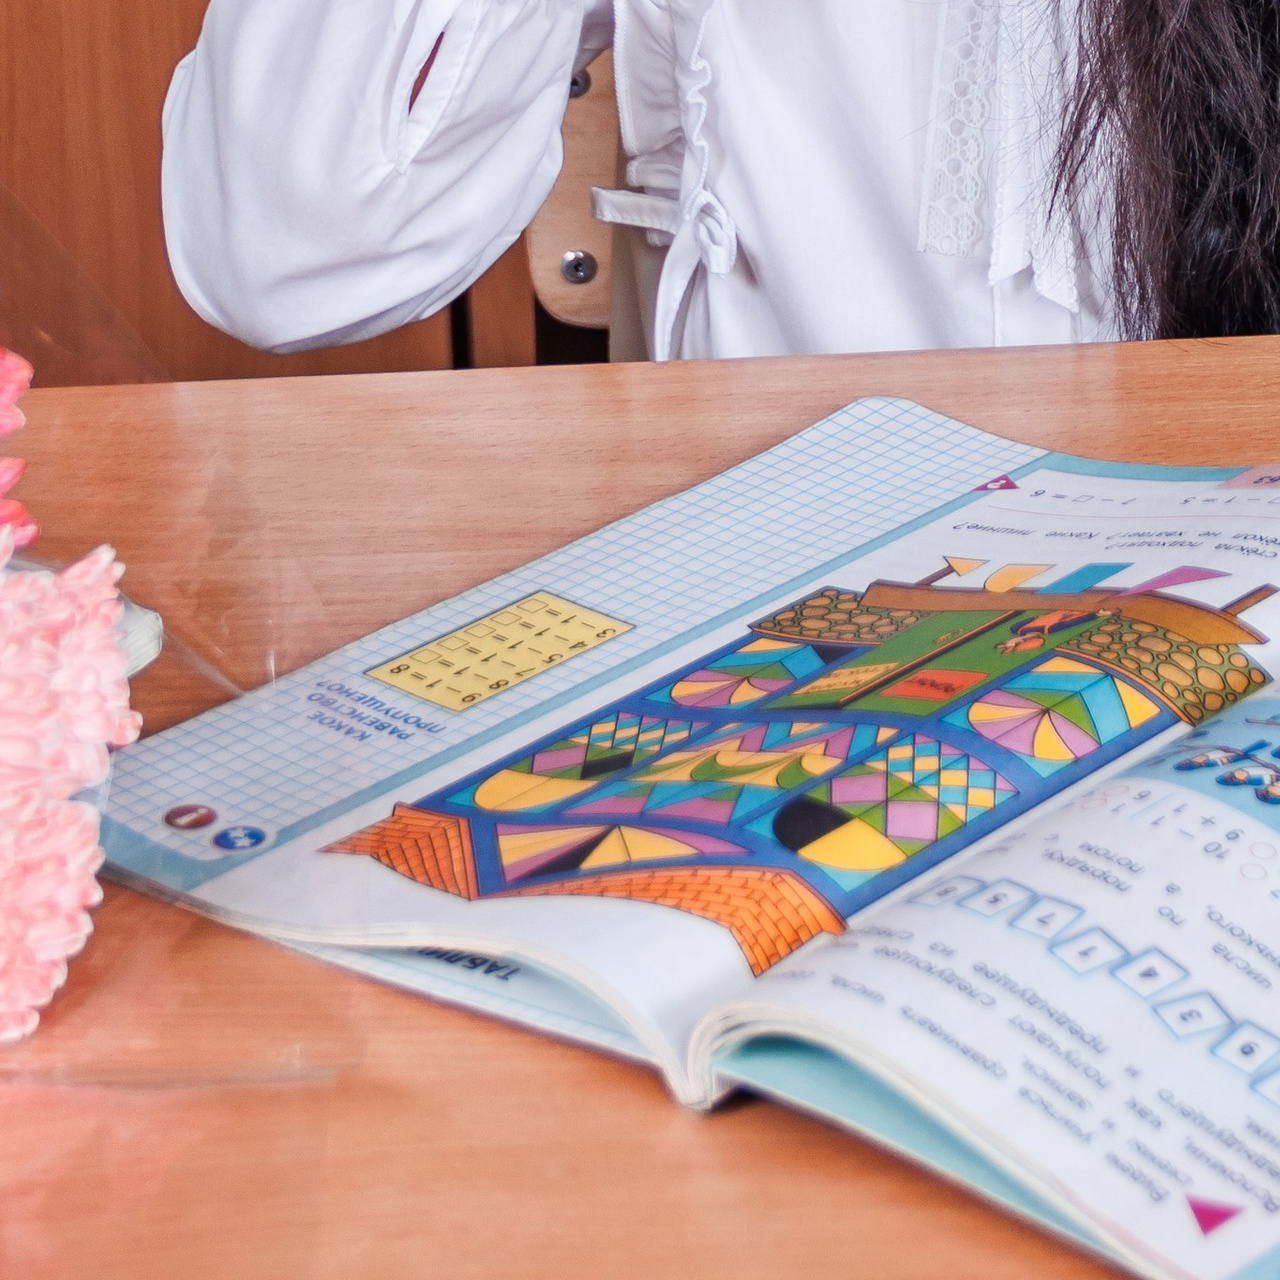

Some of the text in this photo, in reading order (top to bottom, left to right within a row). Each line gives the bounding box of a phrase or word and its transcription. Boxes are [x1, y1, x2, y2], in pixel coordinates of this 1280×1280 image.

[952, 521, 1037, 537] лишние?
[1214, 543, 1279, 560] стёкла
[567, 640, 590, 651] 4
[595, 627, 618, 639] 3
[541, 652, 564, 665] 5
[388, 663, 483, 704] 9 8
[488, 679, 511, 691] 8
[306, 692, 416, 741] РАВЕНСТВО
[315, 678, 448, 735] ПРОПУЩЕНО?
[305, 709, 373, 742] КАКОЕ
[1077, 841, 1146, 877] потом
[1202, 841, 1231, 862] 10
[1155, 905, 1188, 928] по
[1210, 941, 1274, 990] числа
[972, 961, 1111, 1057] предыдущее
[1007, 1015, 1111, 1091] получают
